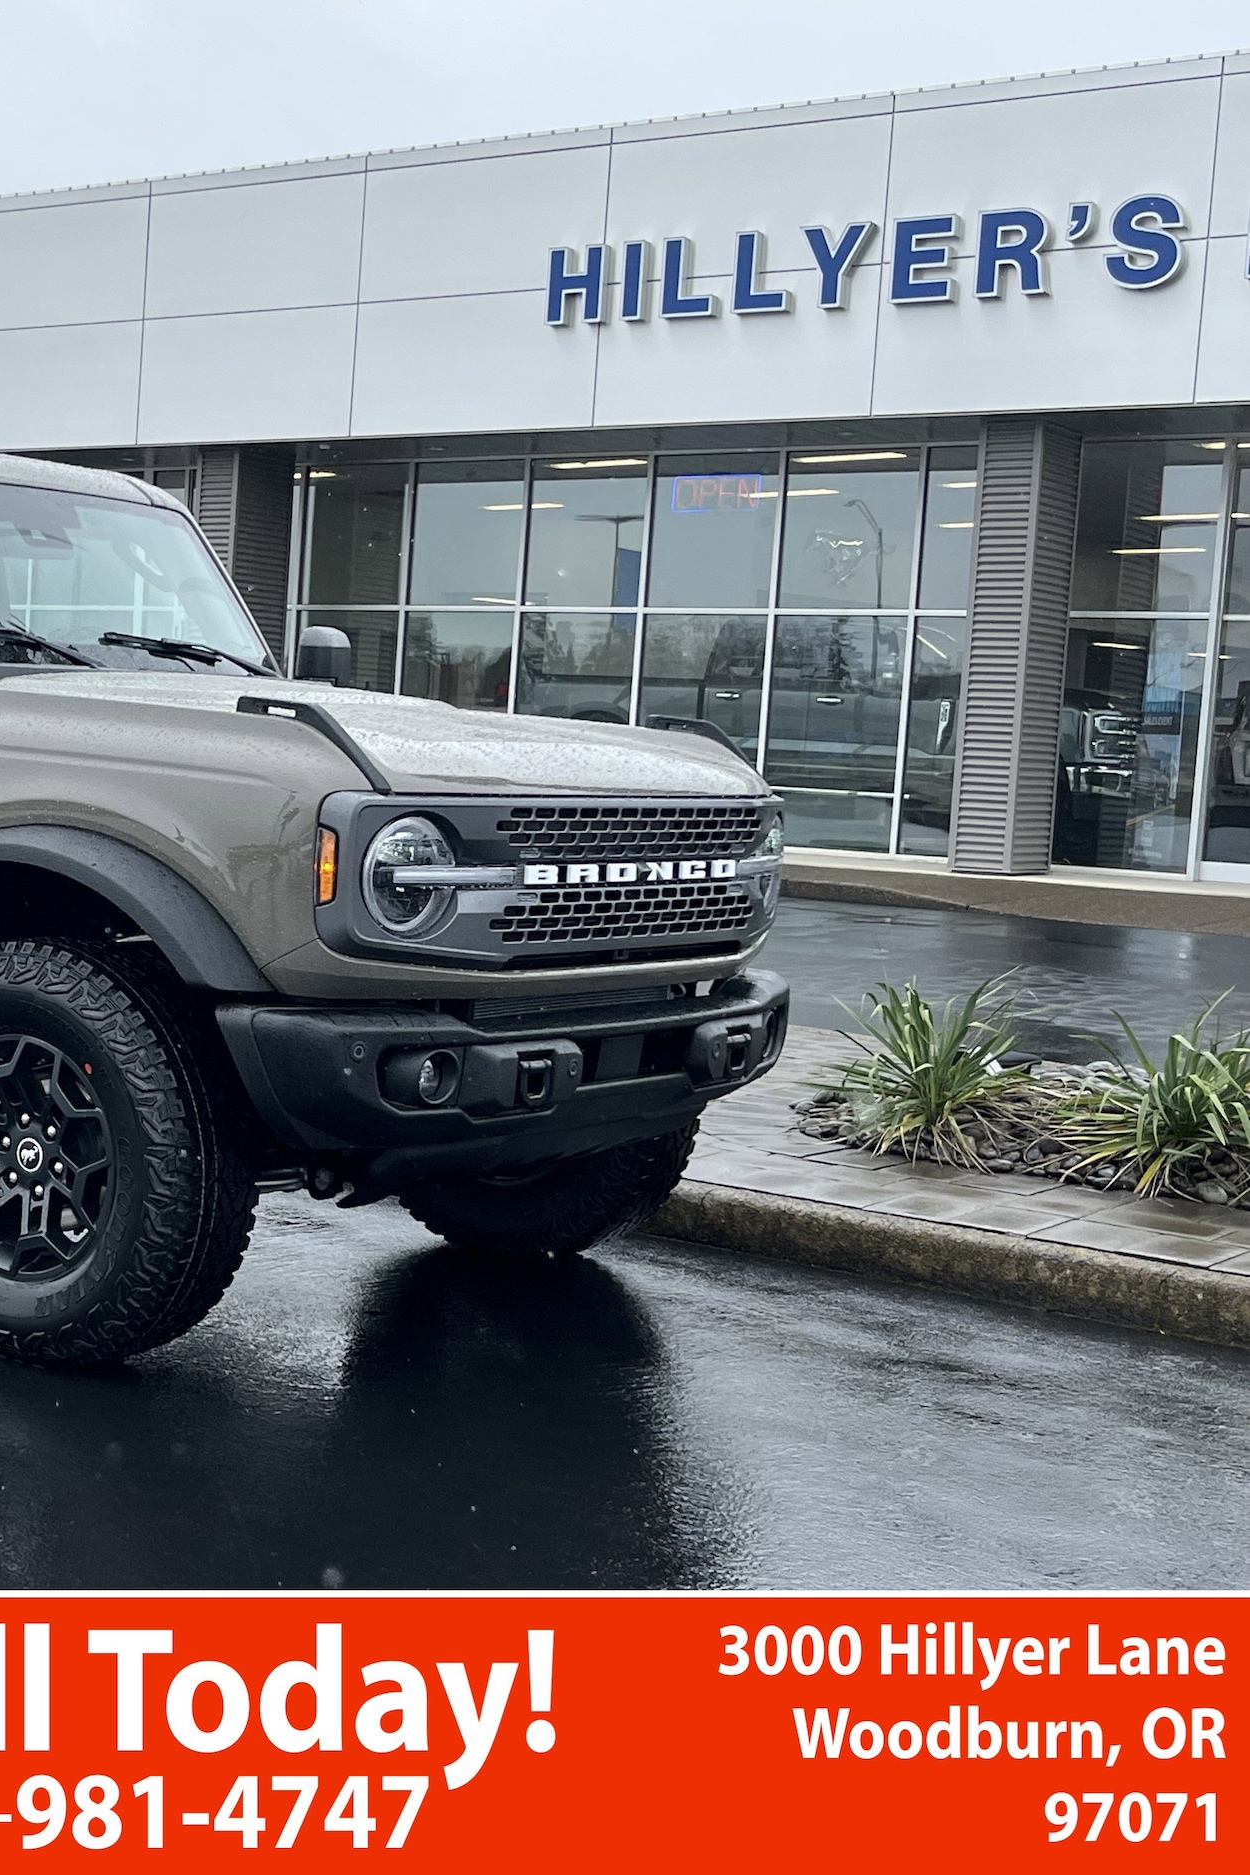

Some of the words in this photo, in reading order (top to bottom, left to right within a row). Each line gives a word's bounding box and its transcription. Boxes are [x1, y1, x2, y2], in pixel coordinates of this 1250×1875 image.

[545, 194, 1188, 327] HILLYER'S
[675, 477, 760, 509] OPEN
[523, 858, 737, 886] BRONCO
